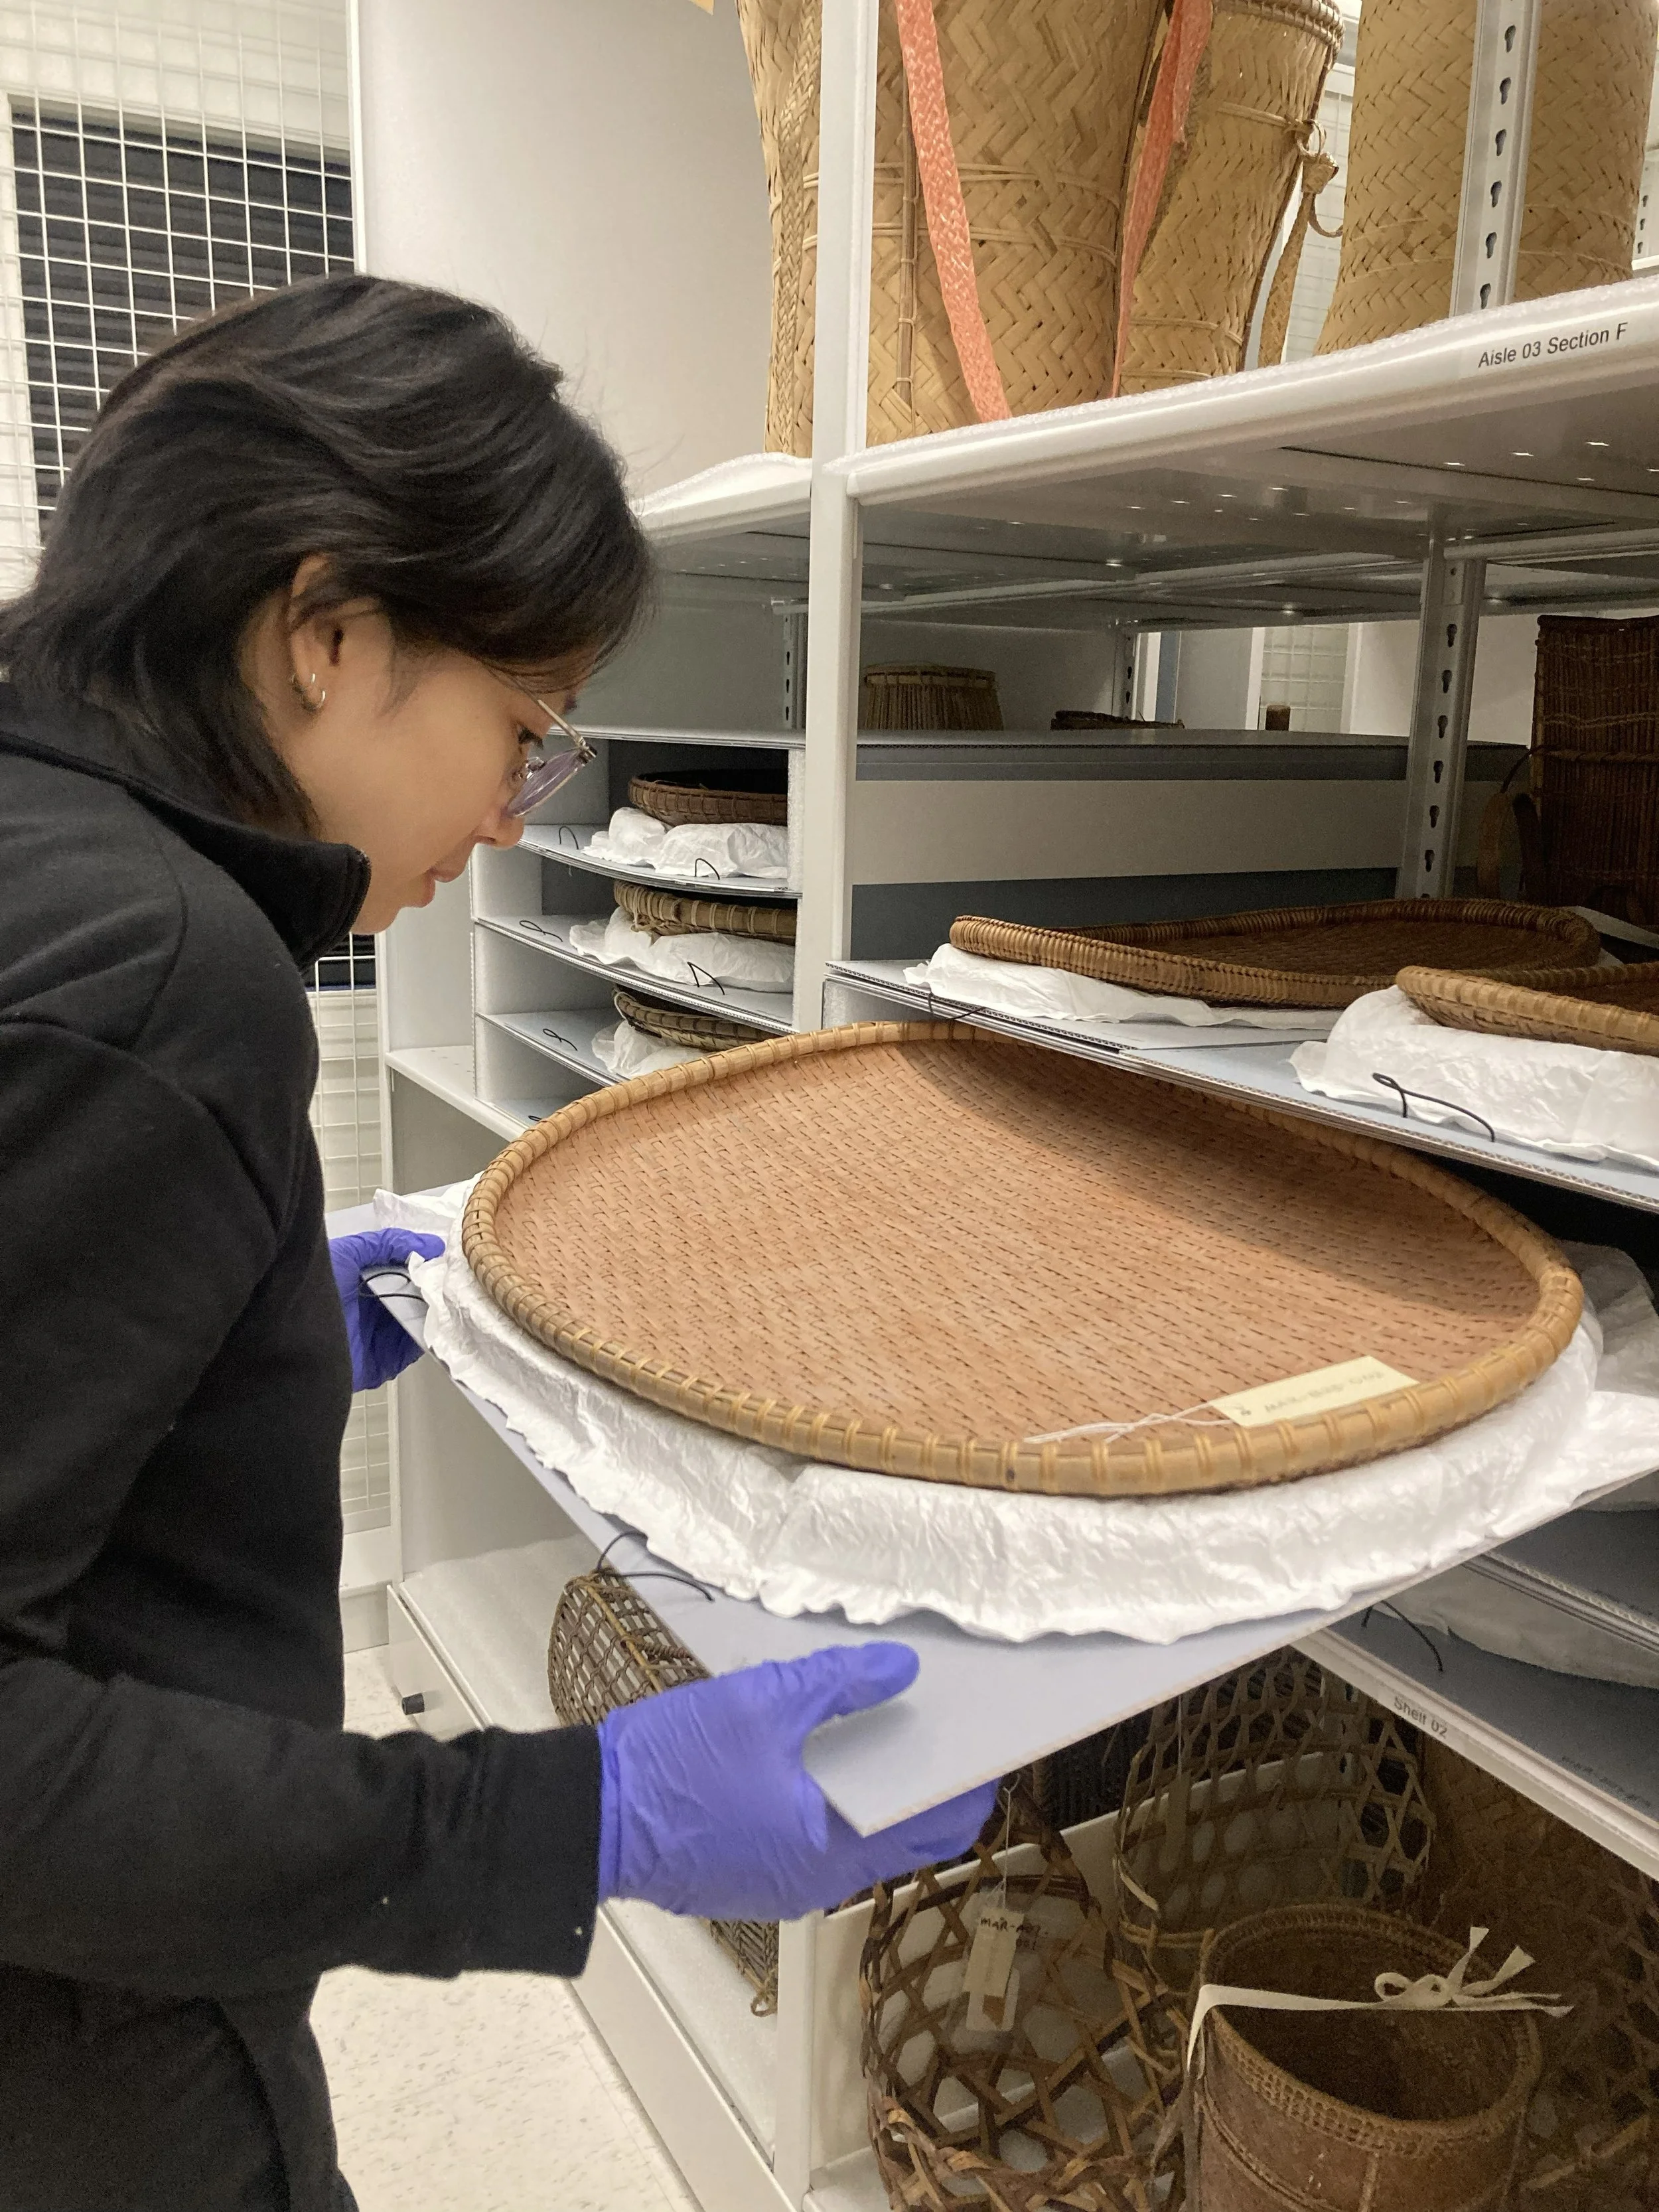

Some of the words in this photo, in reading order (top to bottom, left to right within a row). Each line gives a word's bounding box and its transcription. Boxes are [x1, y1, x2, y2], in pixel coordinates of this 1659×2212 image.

[1478, 348, 1516, 368] Aisle
[1522, 341, 1541, 359] 03
[1547, 330, 1609, 354] Section
[1616, 322, 1628, 340] F
[1394, 1696, 1427, 1725] Shelf
[1431, 1720, 1447, 1738] 02
